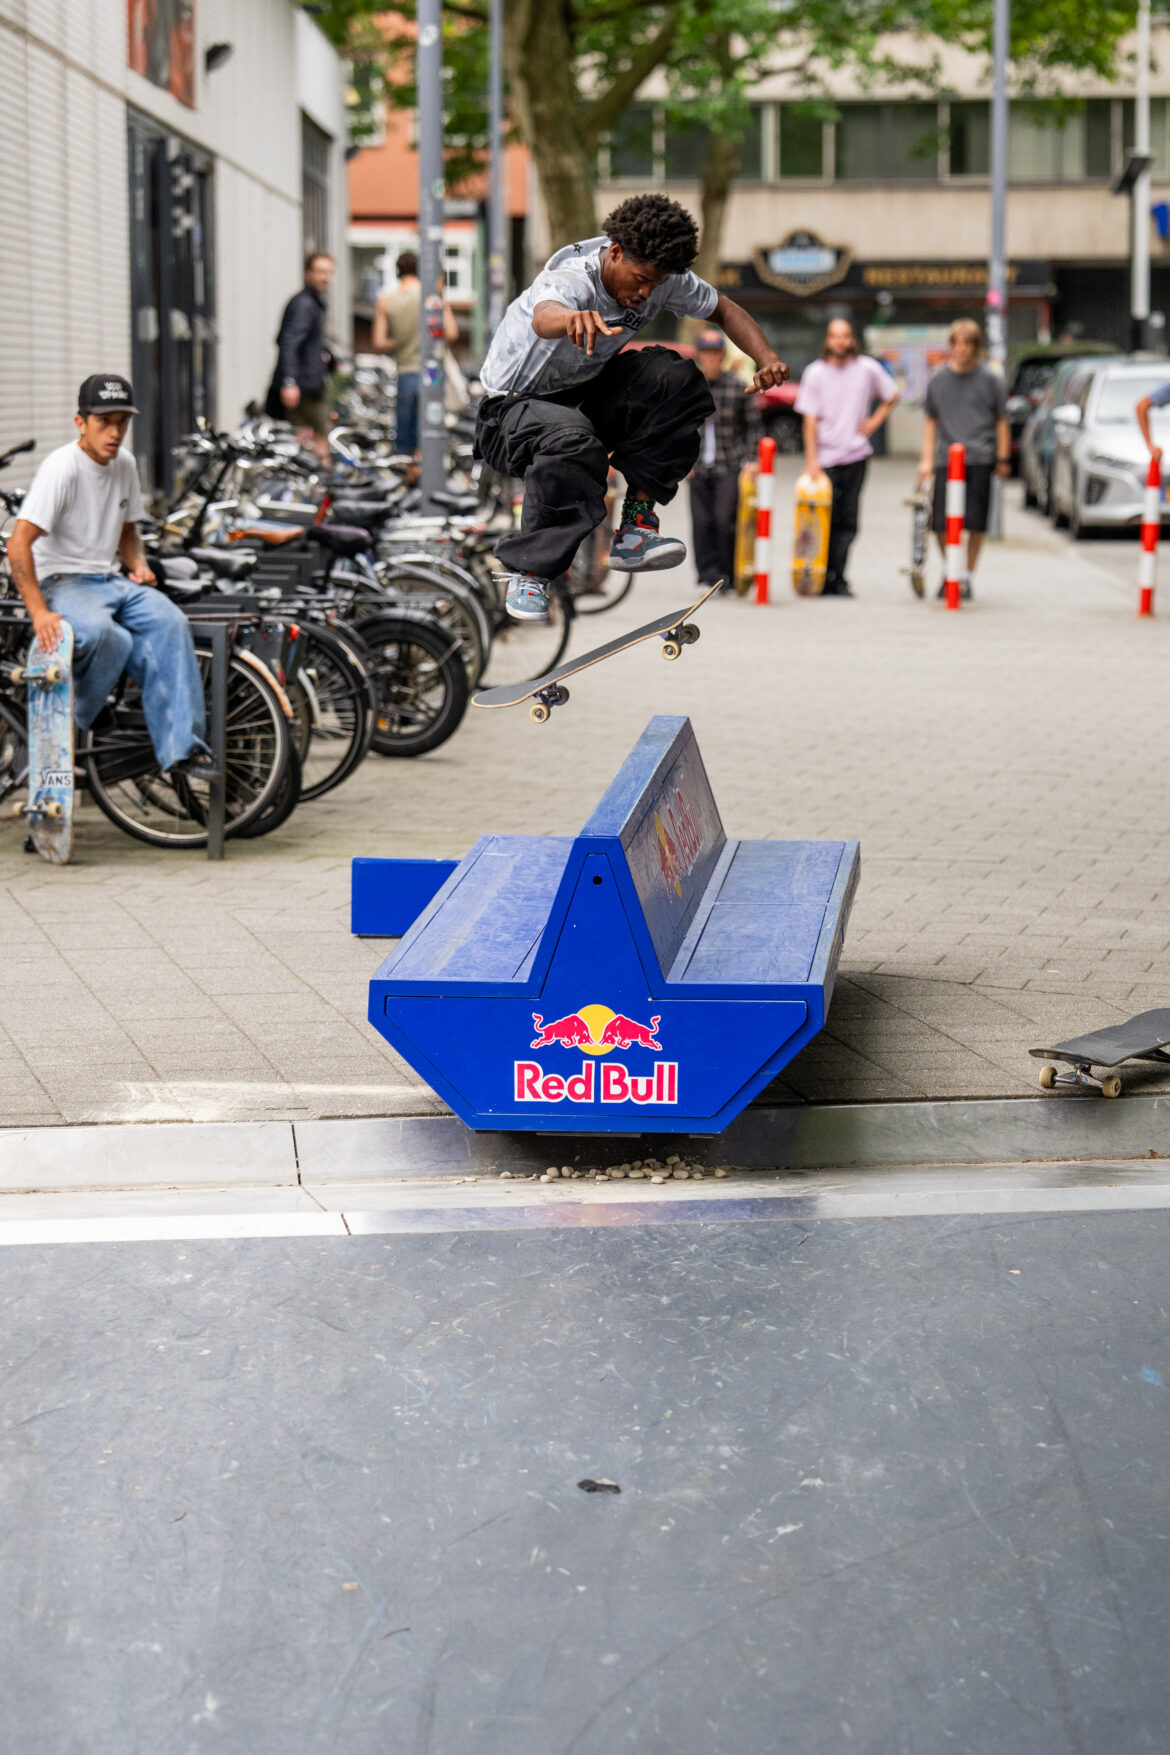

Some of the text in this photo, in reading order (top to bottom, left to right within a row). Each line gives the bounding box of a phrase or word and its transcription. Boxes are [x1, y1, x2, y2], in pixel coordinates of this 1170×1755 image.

[40, 770, 72, 786] VANS
[514, 1060, 678, 1105] Red Bull
